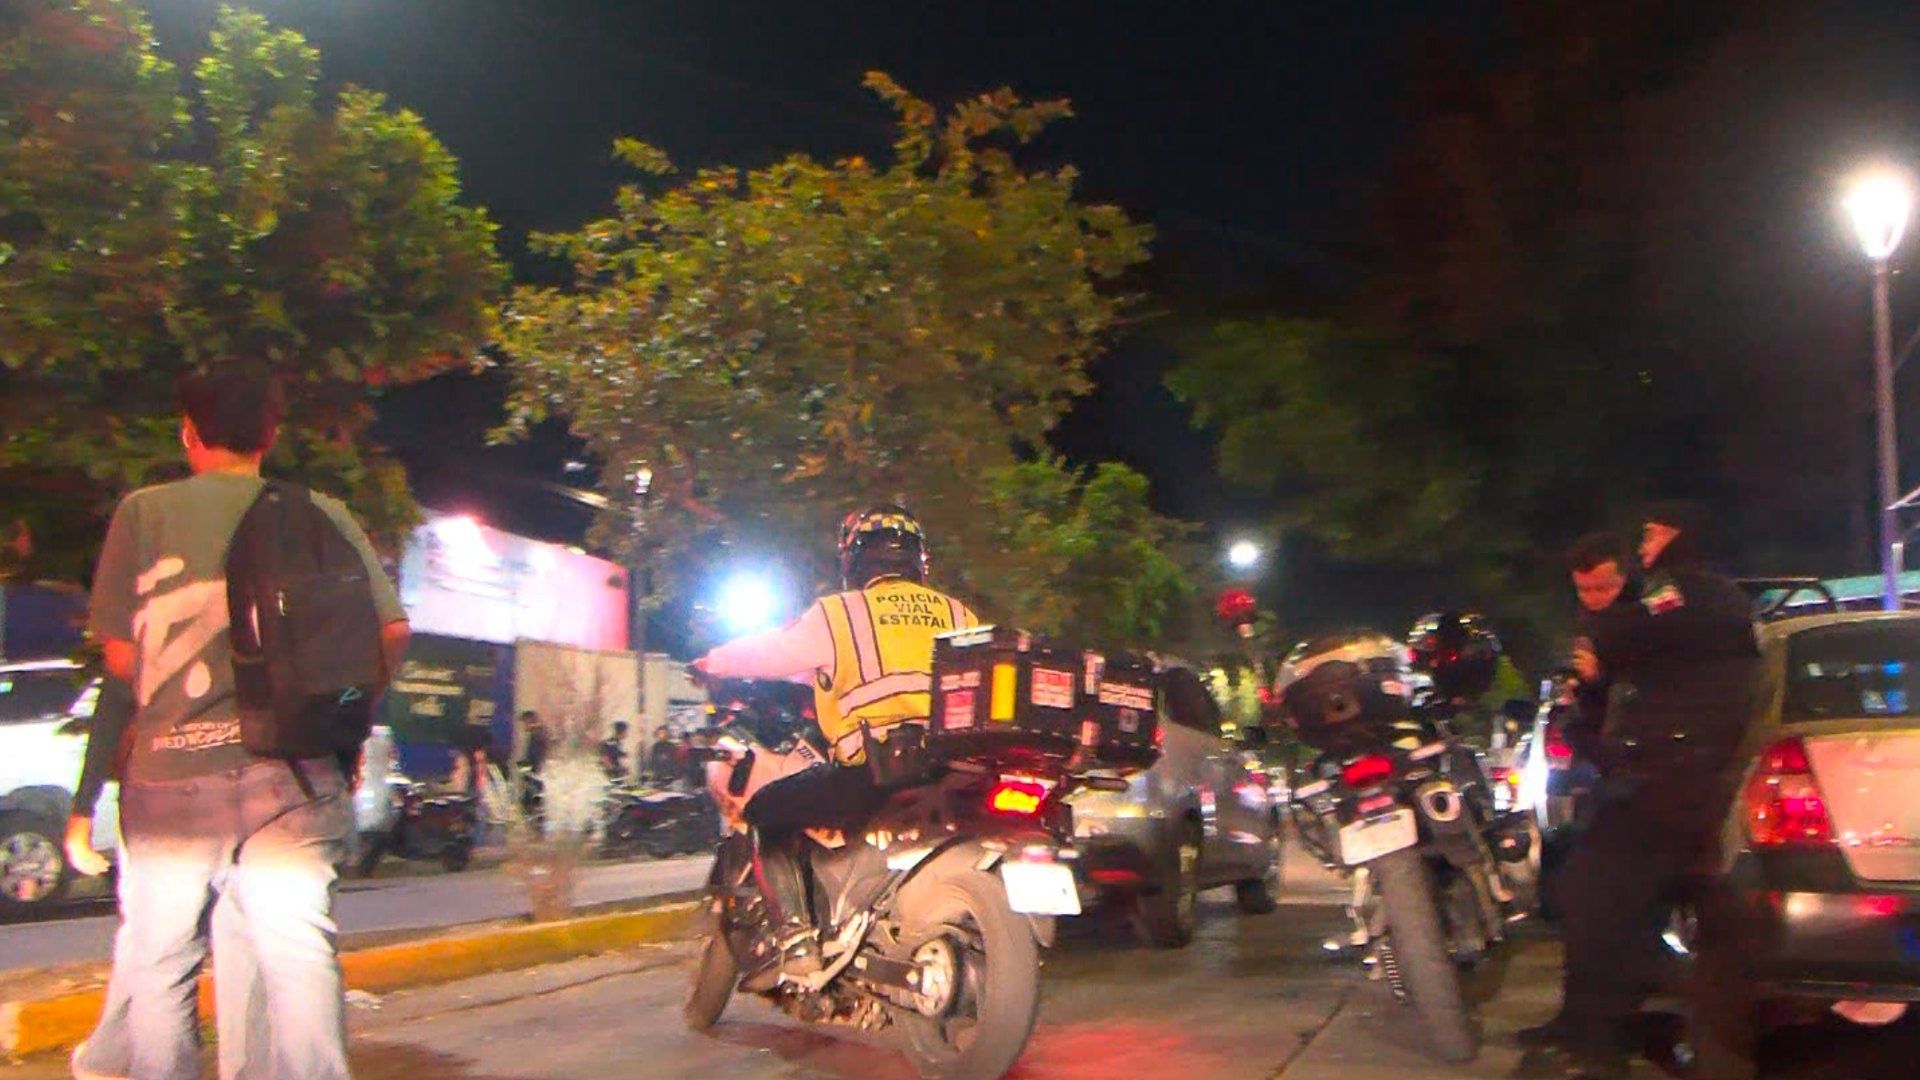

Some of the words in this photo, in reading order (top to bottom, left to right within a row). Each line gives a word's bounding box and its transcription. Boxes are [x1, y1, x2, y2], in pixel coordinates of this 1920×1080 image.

[876, 593, 942, 606] POLICIA
[894, 603, 933, 615] VIAL
[879, 613, 947, 629] ESTATAL
